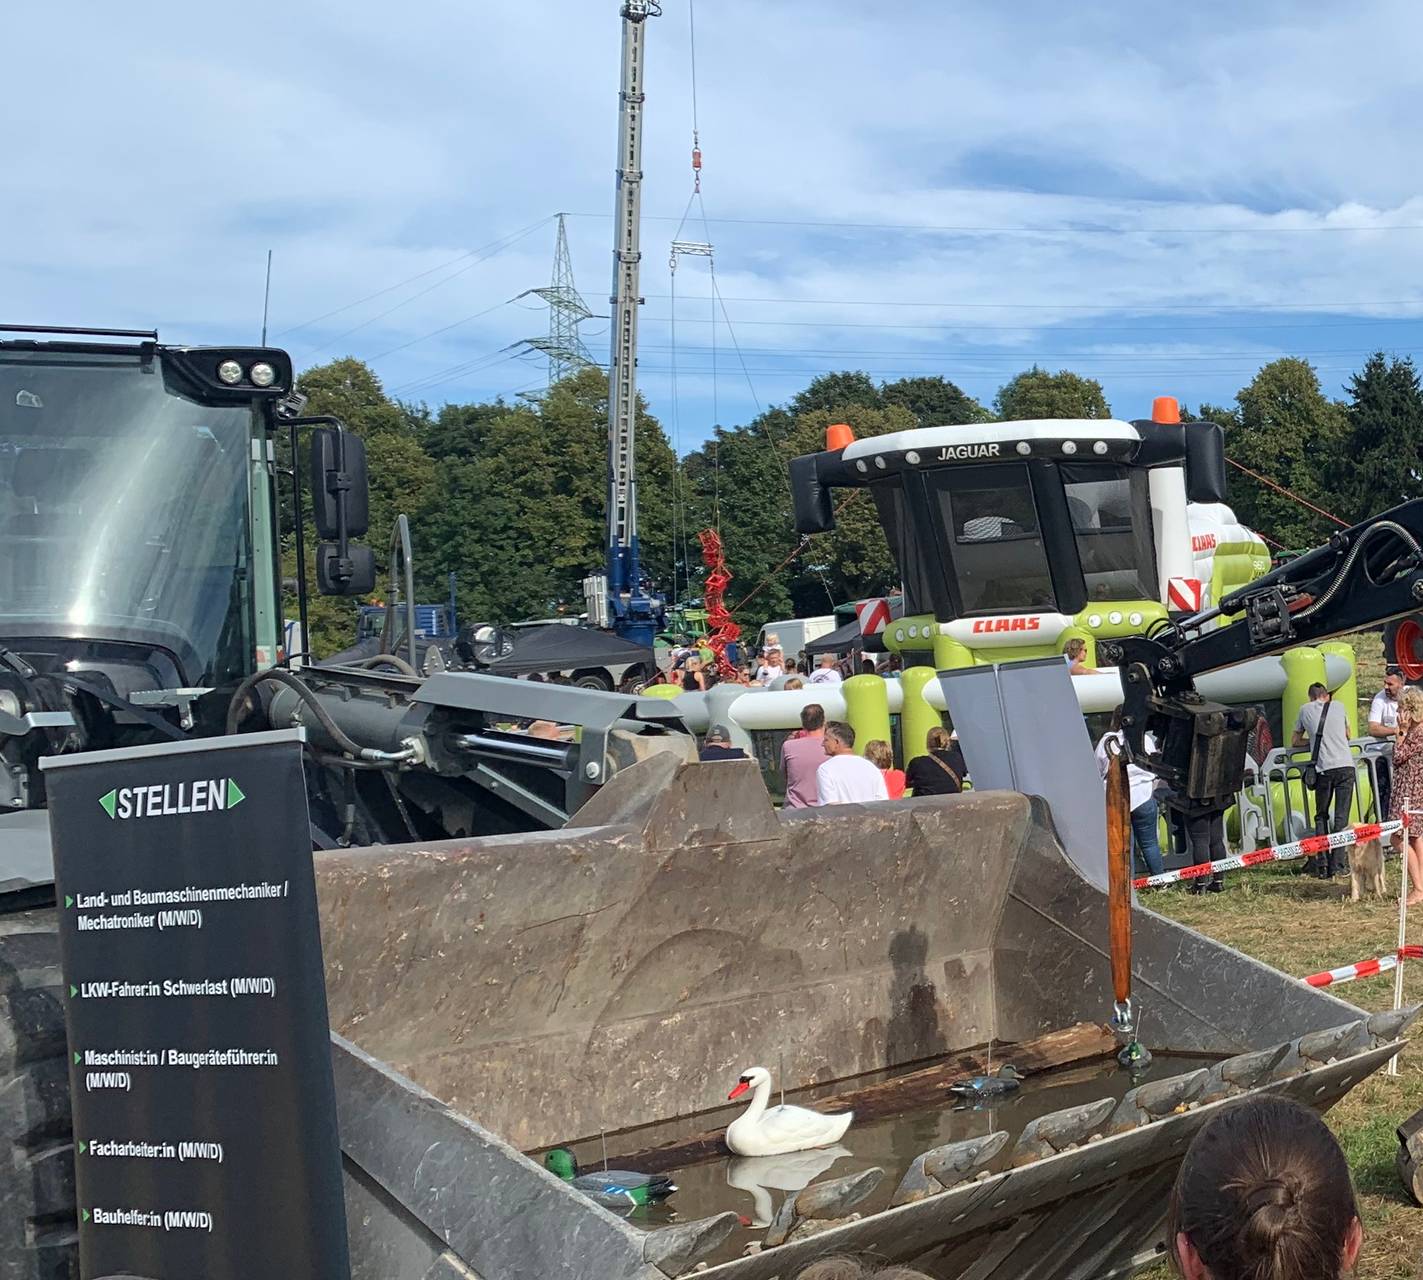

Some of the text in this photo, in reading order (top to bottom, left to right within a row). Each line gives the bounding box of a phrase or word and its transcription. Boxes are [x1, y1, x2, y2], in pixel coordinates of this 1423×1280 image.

[937, 443, 1000, 461] JAGUAR
[1191, 533, 1217, 552] CLAAS
[973, 617, 1041, 634] CLAAS
[117, 778, 226, 819] STELLEN
[76, 891, 109, 909] Land-
[111, 889, 131, 906] und
[133, 882, 281, 906] Baumaschinenmechaniker
[77, 909, 202, 931] Mechatroniker (M/W/D)
[81, 977, 275, 998] LKW-Fahrer:in Schwerlast (M/W/D)
[84, 1049, 158, 1066] Maschinist:in
[168, 1048, 278, 1069] Baugeräteführer:in
[86, 1072, 131, 1091] (M/W/D)
[89, 1140, 223, 1163] Facharbeiter:in (M/W/D)
[93, 1208, 212, 1232] Bauhelfer:in (M/W/D)
